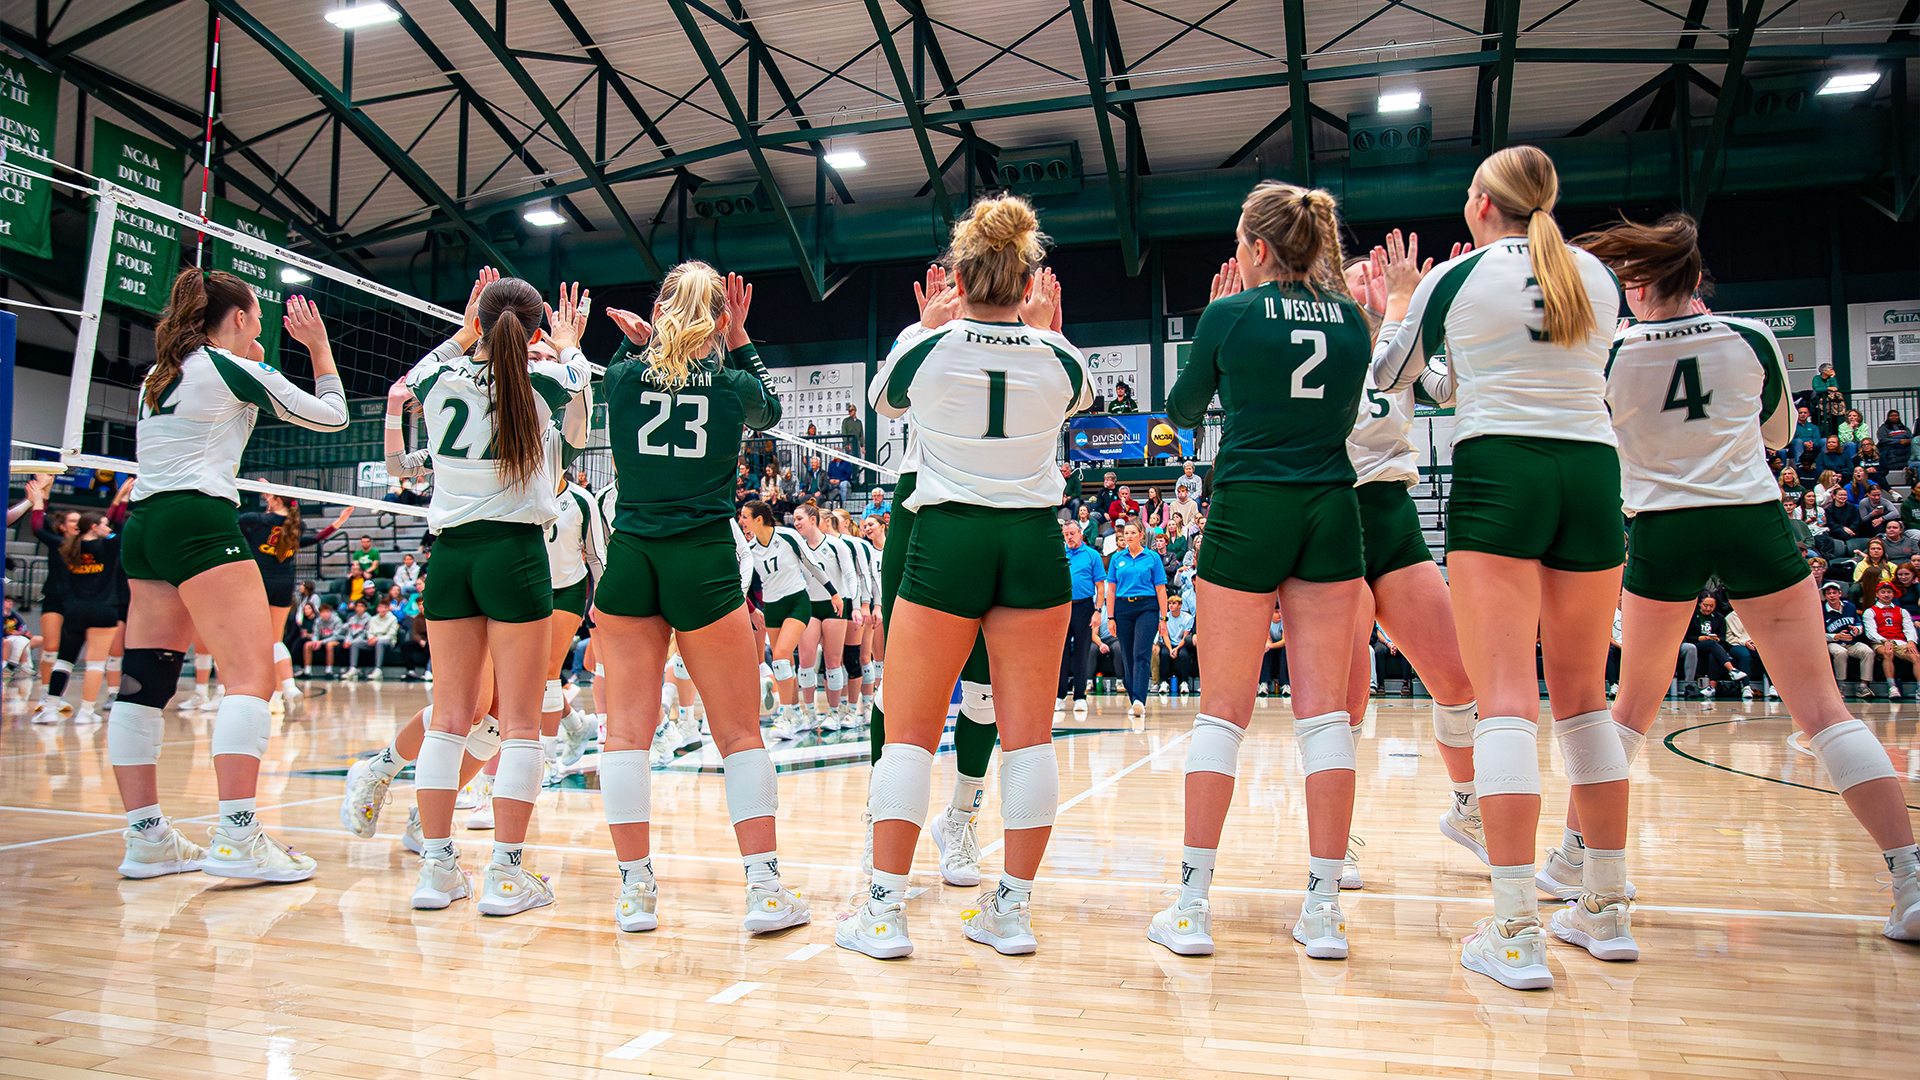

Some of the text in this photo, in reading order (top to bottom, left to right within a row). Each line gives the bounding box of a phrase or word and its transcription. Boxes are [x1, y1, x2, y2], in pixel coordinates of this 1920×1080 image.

[122, 144, 160, 171] NCAA
[118, 165, 144, 186] DIV.
[145, 174, 161, 193] III
[116, 230, 156, 255] FINAL
[236, 219, 267, 241] NCAA
[115, 252, 153, 276] FOUR
[119, 277, 146, 295] 2012
[1264, 297, 1344, 324] IL WESLEYAN
[964, 329, 1031, 346] TITANS
[1171, 321, 1181, 336] L
[1290, 329, 1327, 399] 2
[770, 375, 793, 384] RICA
[1660, 355, 1713, 423] 4
[980, 368, 1009, 439] 1
[1366, 388, 1390, 418] 5
[638, 391, 709, 459] 23
[1092, 434, 1131, 443] DIVISION
[1132, 433, 1141, 441] III
[763, 556, 778, 574] 17
